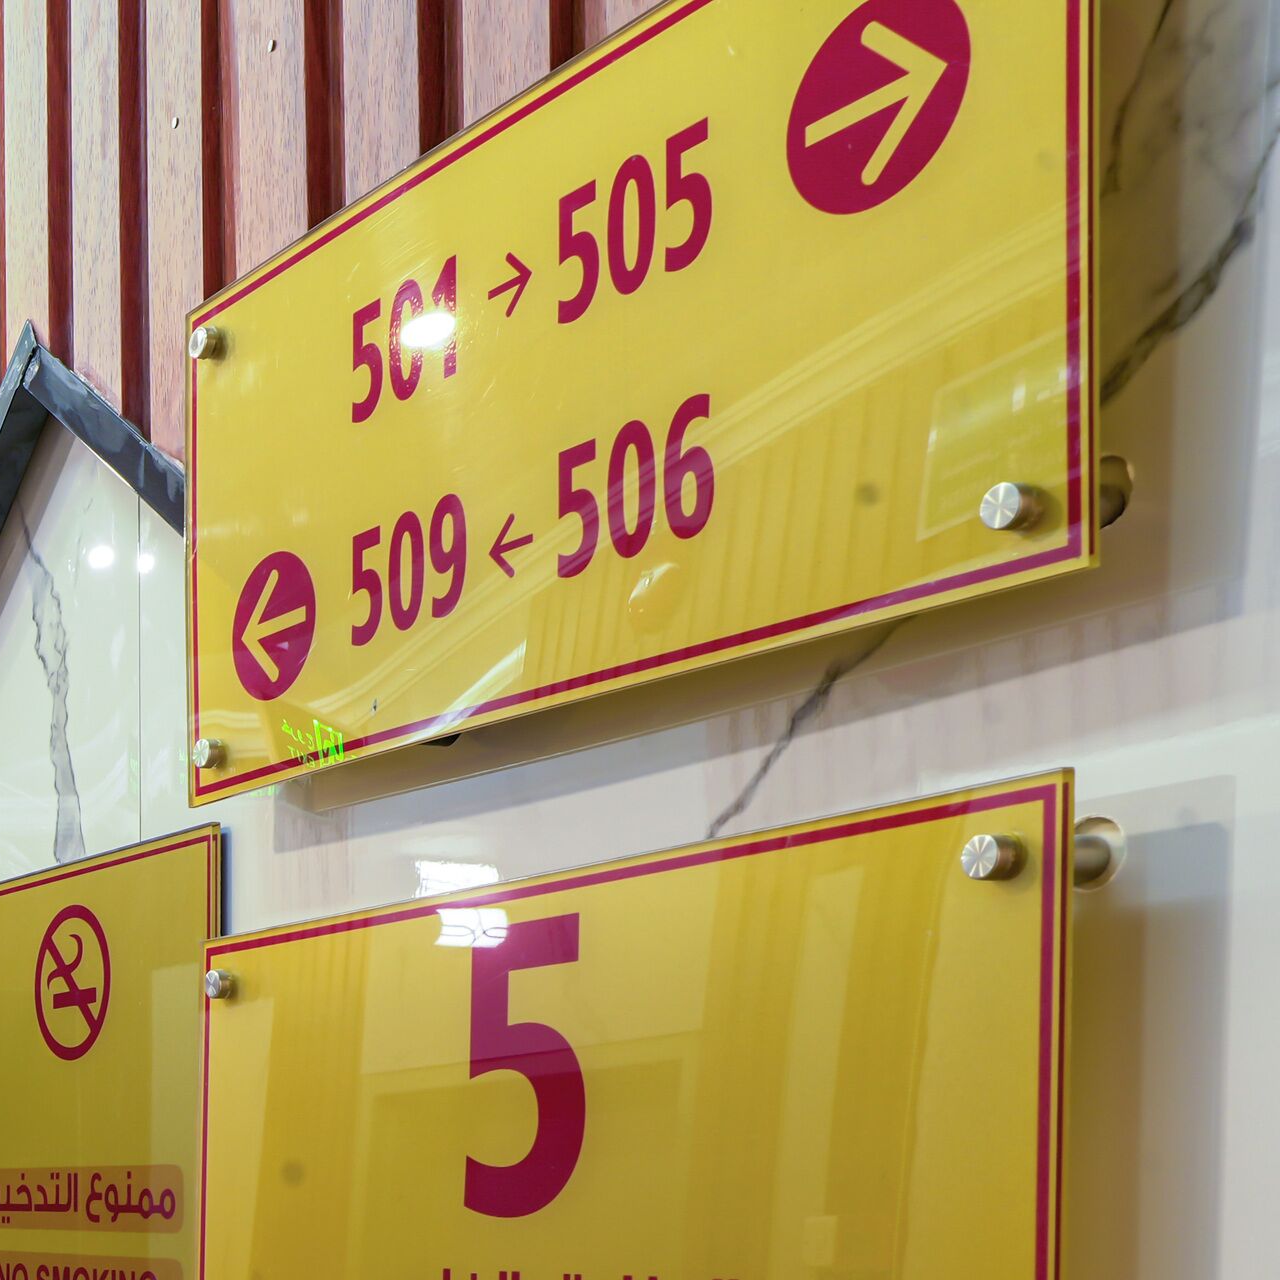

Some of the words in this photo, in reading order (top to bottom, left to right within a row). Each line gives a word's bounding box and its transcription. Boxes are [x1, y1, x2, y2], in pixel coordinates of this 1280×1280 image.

[351, 254, 457, 424] 501
[557, 117, 713, 325] 505
[351, 493, 467, 647] 509
[557, 393, 715, 579] 506
[85, 1171, 177, 1223] ممنوع
[462, 912, 587, 1219] 5
